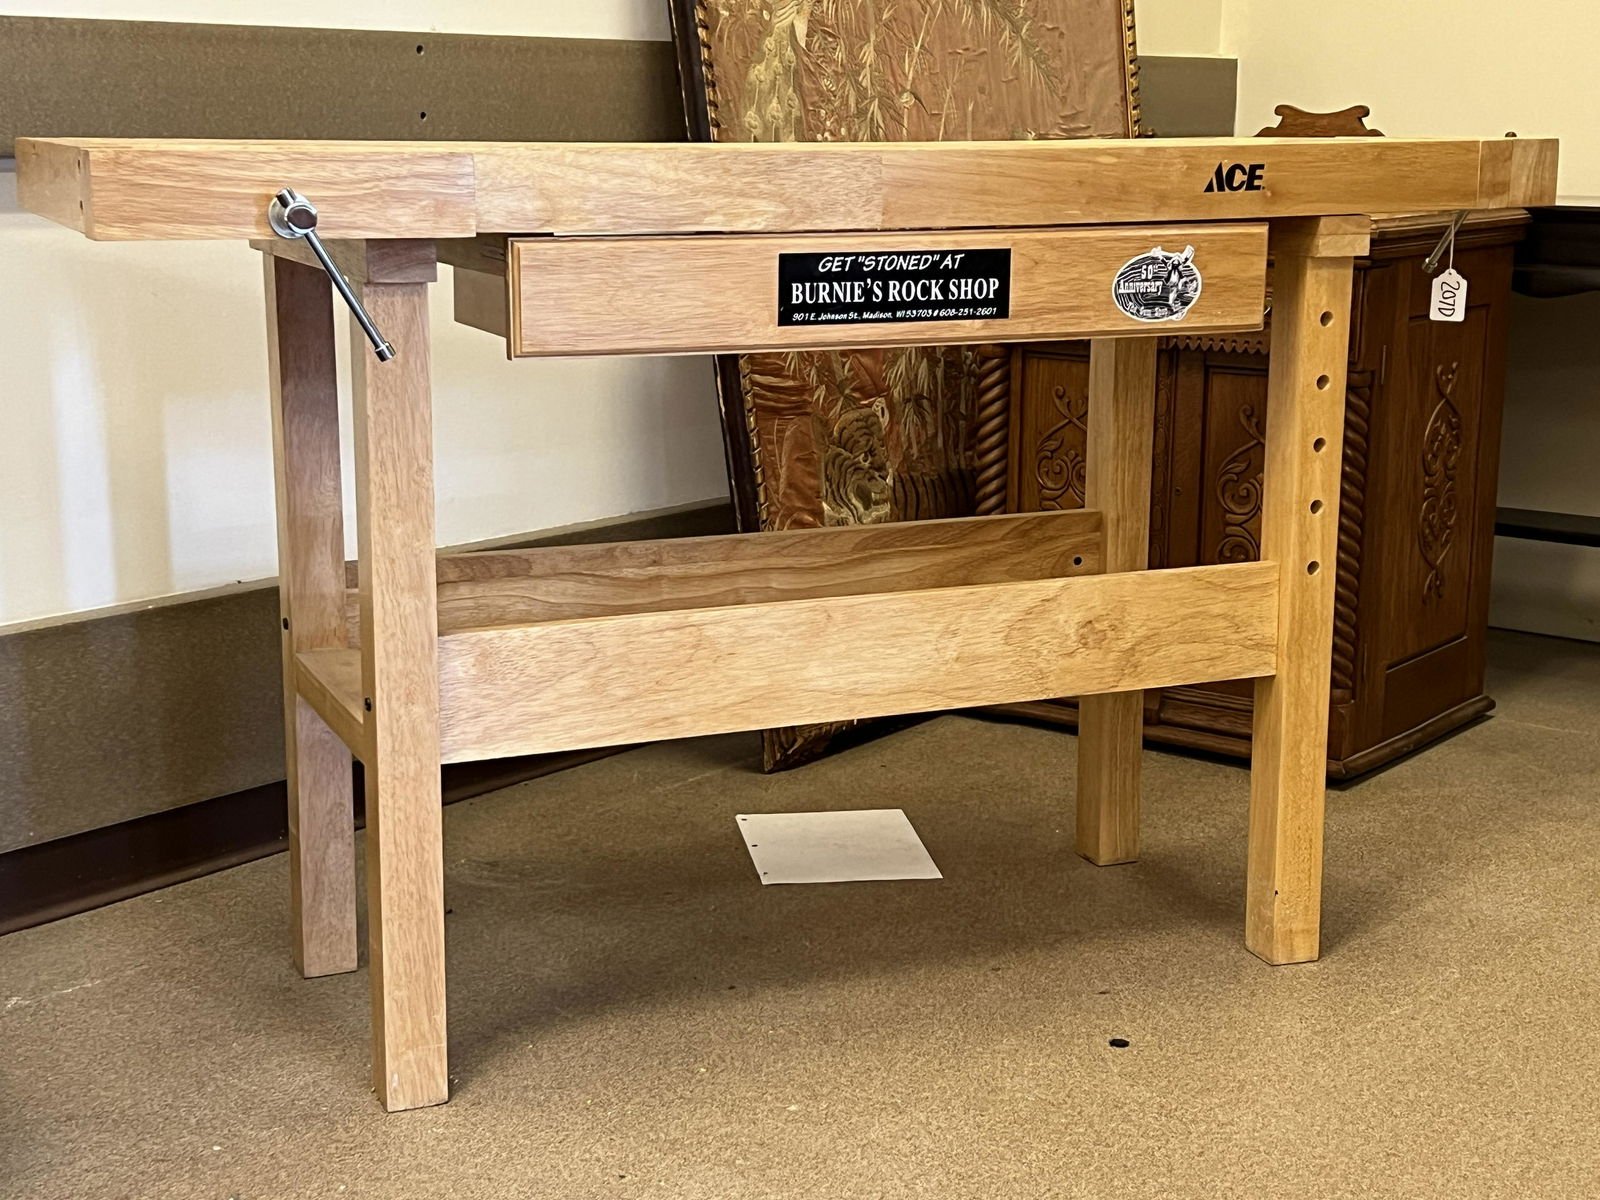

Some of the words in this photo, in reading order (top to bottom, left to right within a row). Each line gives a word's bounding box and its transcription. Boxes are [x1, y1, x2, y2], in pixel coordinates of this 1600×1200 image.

[1204, 162, 1265, 192] ACE
[818, 256, 856, 272] GET
[858, 255, 939, 271] "STONED"
[940, 254, 964, 269] AT
[791, 278, 883, 304] BURNIE'S
[888, 279, 944, 302] ROCK
[948, 278, 999, 300] SHOP
[1119, 280, 1163, 295] Anniversary
[1437, 280, 1461, 317] 207D
[792, 313, 808, 321] 901
[818, 312, 847, 320] Johnson
[906, 309, 932, 318] 53703
[939, 307, 997, 316] 608-251-2601
